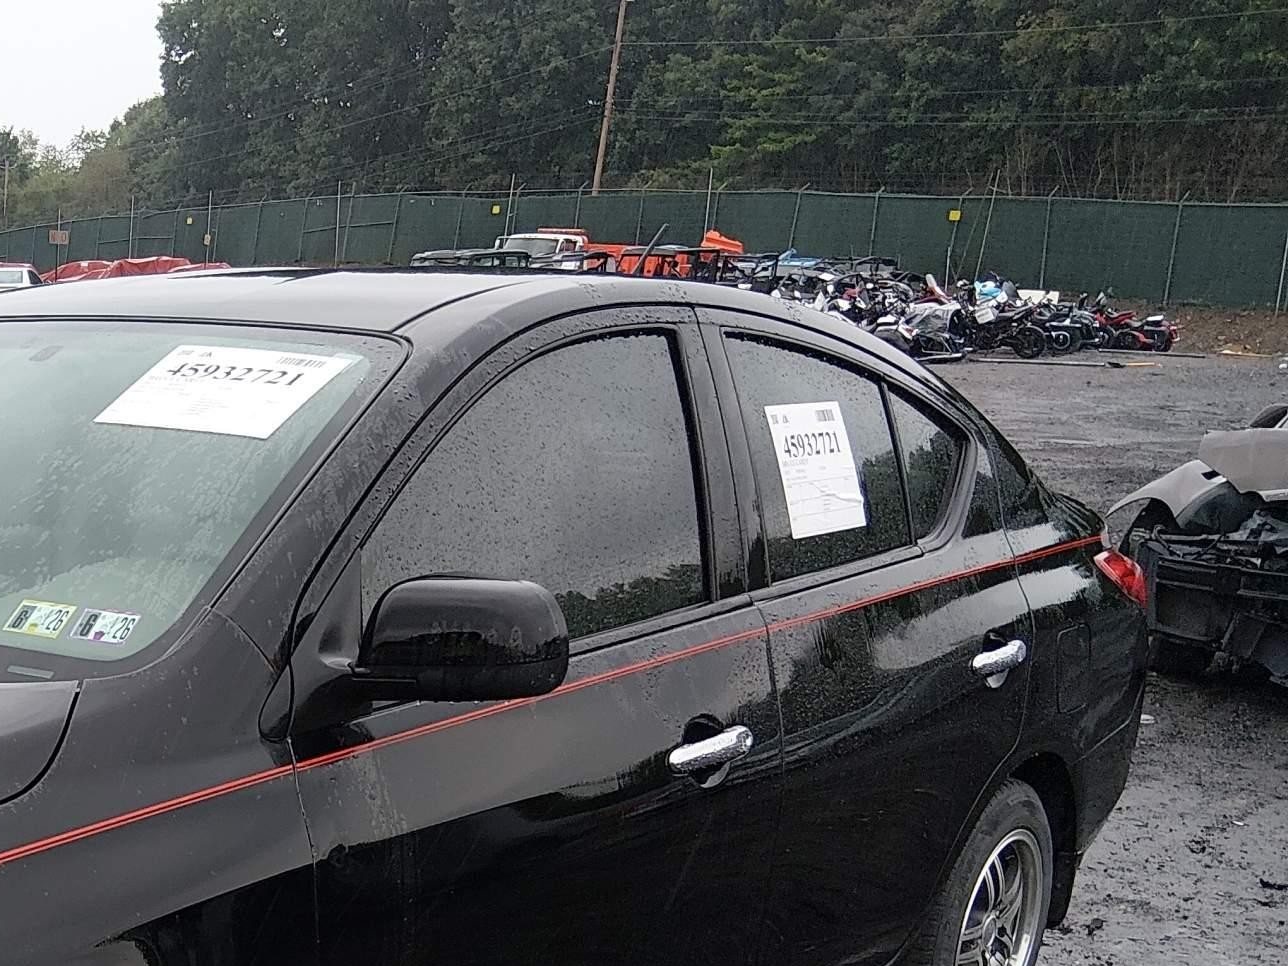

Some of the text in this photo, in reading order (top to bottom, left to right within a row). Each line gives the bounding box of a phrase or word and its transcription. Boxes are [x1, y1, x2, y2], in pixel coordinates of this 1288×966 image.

[166, 362, 305, 386] 45932721
[783, 430, 841, 458] 45932721
[45, 609, 70, 632] 26
[112, 616, 137, 641] 26
